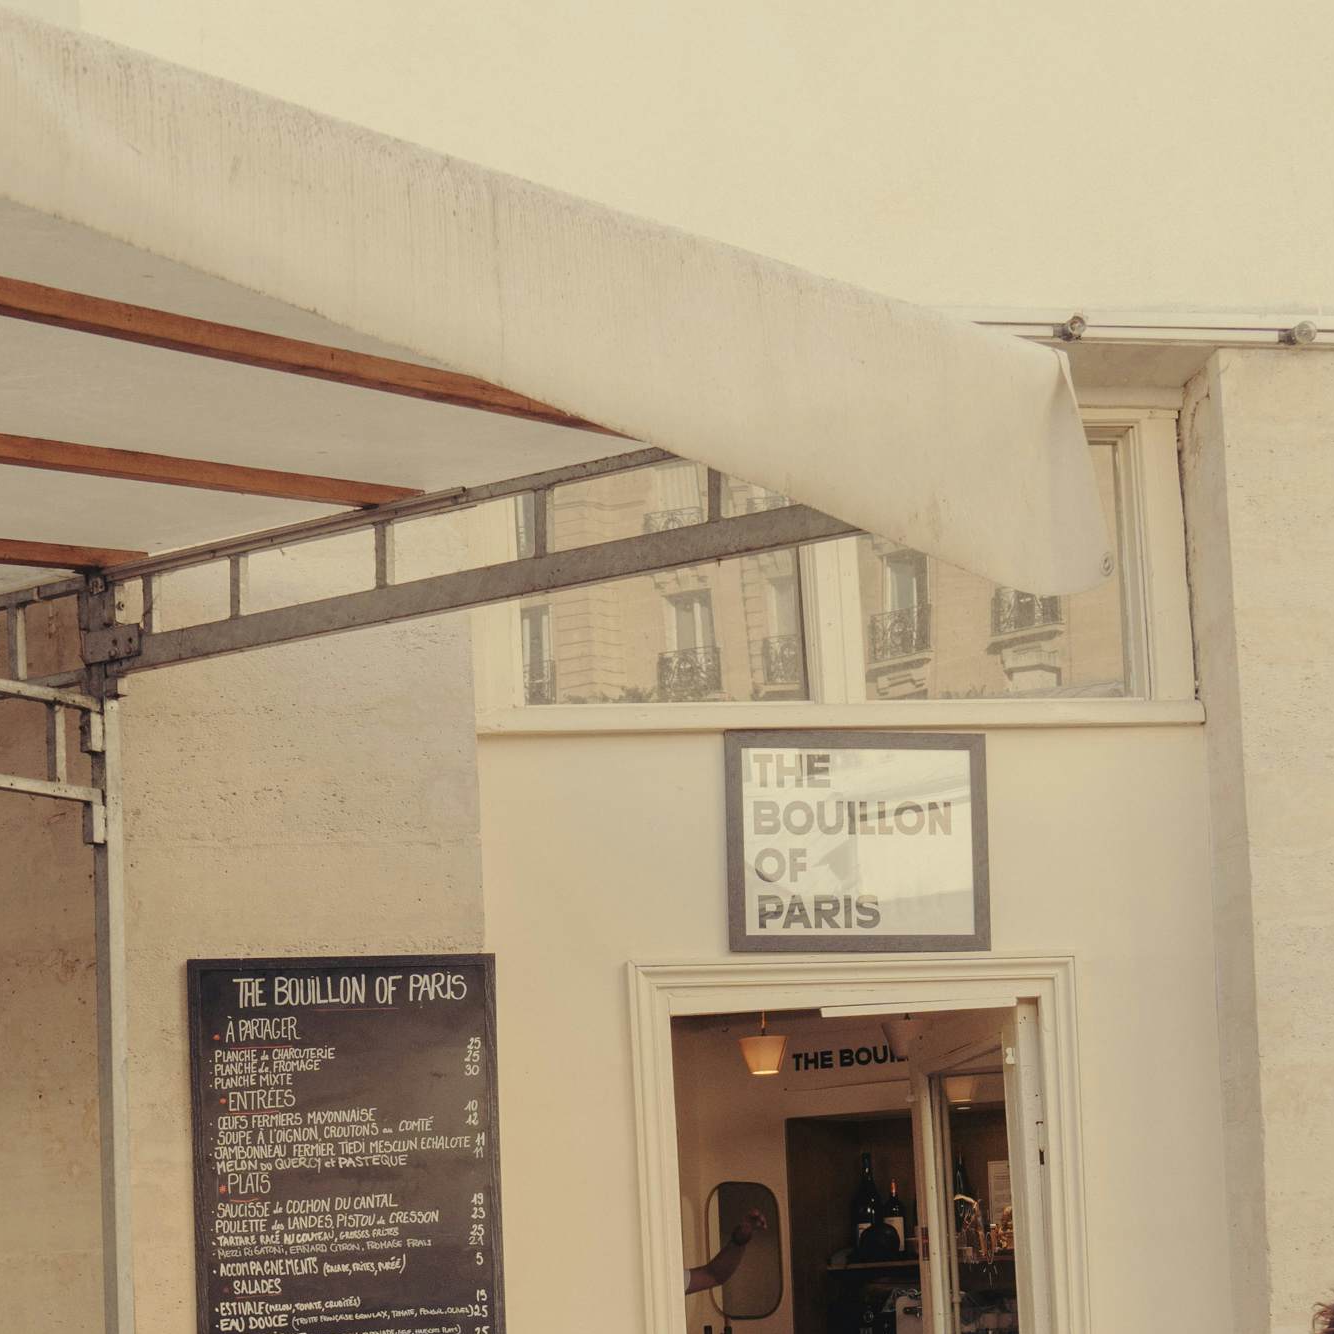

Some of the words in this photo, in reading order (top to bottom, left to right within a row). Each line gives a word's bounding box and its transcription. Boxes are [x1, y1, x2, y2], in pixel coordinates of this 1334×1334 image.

[752, 754, 831, 788] THE
[753, 800, 952, 836] BOUILLON
[754, 847, 807, 883] OF
[758, 894, 881, 929] PARIS
[233, 977, 267, 1008] THE
[274, 974, 365, 1006] BOUILLON
[375, 975, 402, 1005] OF
[409, 971, 467, 1001] PARIS
[225, 1015, 235, 1043] À
[238, 1016, 301, 1041] PARTAGER
[215, 1049, 257, 1062] PLANCHE
[272, 1045, 335, 1060] CHARCUTERIE
[467, 1036, 482, 1050] 25
[464, 1050, 480, 1062] 25
[792, 1050, 834, 1071] THE
[214, 1061, 257, 1076] PLANCHE
[273, 1059, 322, 1073] FROMAGE
[464, 1064, 480, 1076] 30
[214, 1073, 257, 1090] PLANCHE
[259, 1071, 293, 1087] MIXTE
[228, 1087, 296, 1112] ENTRÉES
[464, 1099, 478, 1111] 10
[252, 1113, 302, 1129] FERMIERS
[307, 1108, 377, 1125] MAYONNAISE
[465, 1112, 479, 1125] 12
[217, 1130, 253, 1146] SOUPE
[323, 1122, 379, 1138] CROUTONS
[398, 1116, 434, 1132] COMTÉ
[214, 1144, 287, 1160] JAMBONNEAU
[293, 1142, 335, 1157] FERMIER
[369, 1136, 418, 1153] MESCLUN
[420, 1135, 471, 1150] ECHALOTE
[475, 1132, 486, 1146] 11
[473, 1146, 484, 1158] 11
[217, 1159, 258, 1175] MELON
[274, 1157, 321, 1174] QUERCY
[338, 1154, 408, 1168] PASTEQUE
[228, 1171, 271, 1194] PLATS
[217, 1201, 271, 1218] SAUCISSE
[286, 1197, 330, 1214] COCHON
[334, 1196, 351, 1211] DU
[353, 1193, 399, 1210] CANTAL
[471, 1192, 484, 1205] 19
[215, 1219, 267, 1233] POULETTE
[336, 1213, 375, 1228] PISTOU
[389, 1209, 440, 1224] CRESSON
[470, 1206, 486, 1219] 23
[470, 1223, 485, 1236] 25
[217, 1235, 256, 1247] TARTARE
[366, 1239, 403, 1250] FROMAGE
[220, 1256, 319, 1277] ACCOMPAGNEMENTS
[476, 1252, 484, 1265] 5
[233, 1277, 282, 1295] SALADES
[219, 1316, 245, 1332] EAU
[248, 1314, 289, 1330] DOUCE
[473, 1304, 488, 1318] 25
